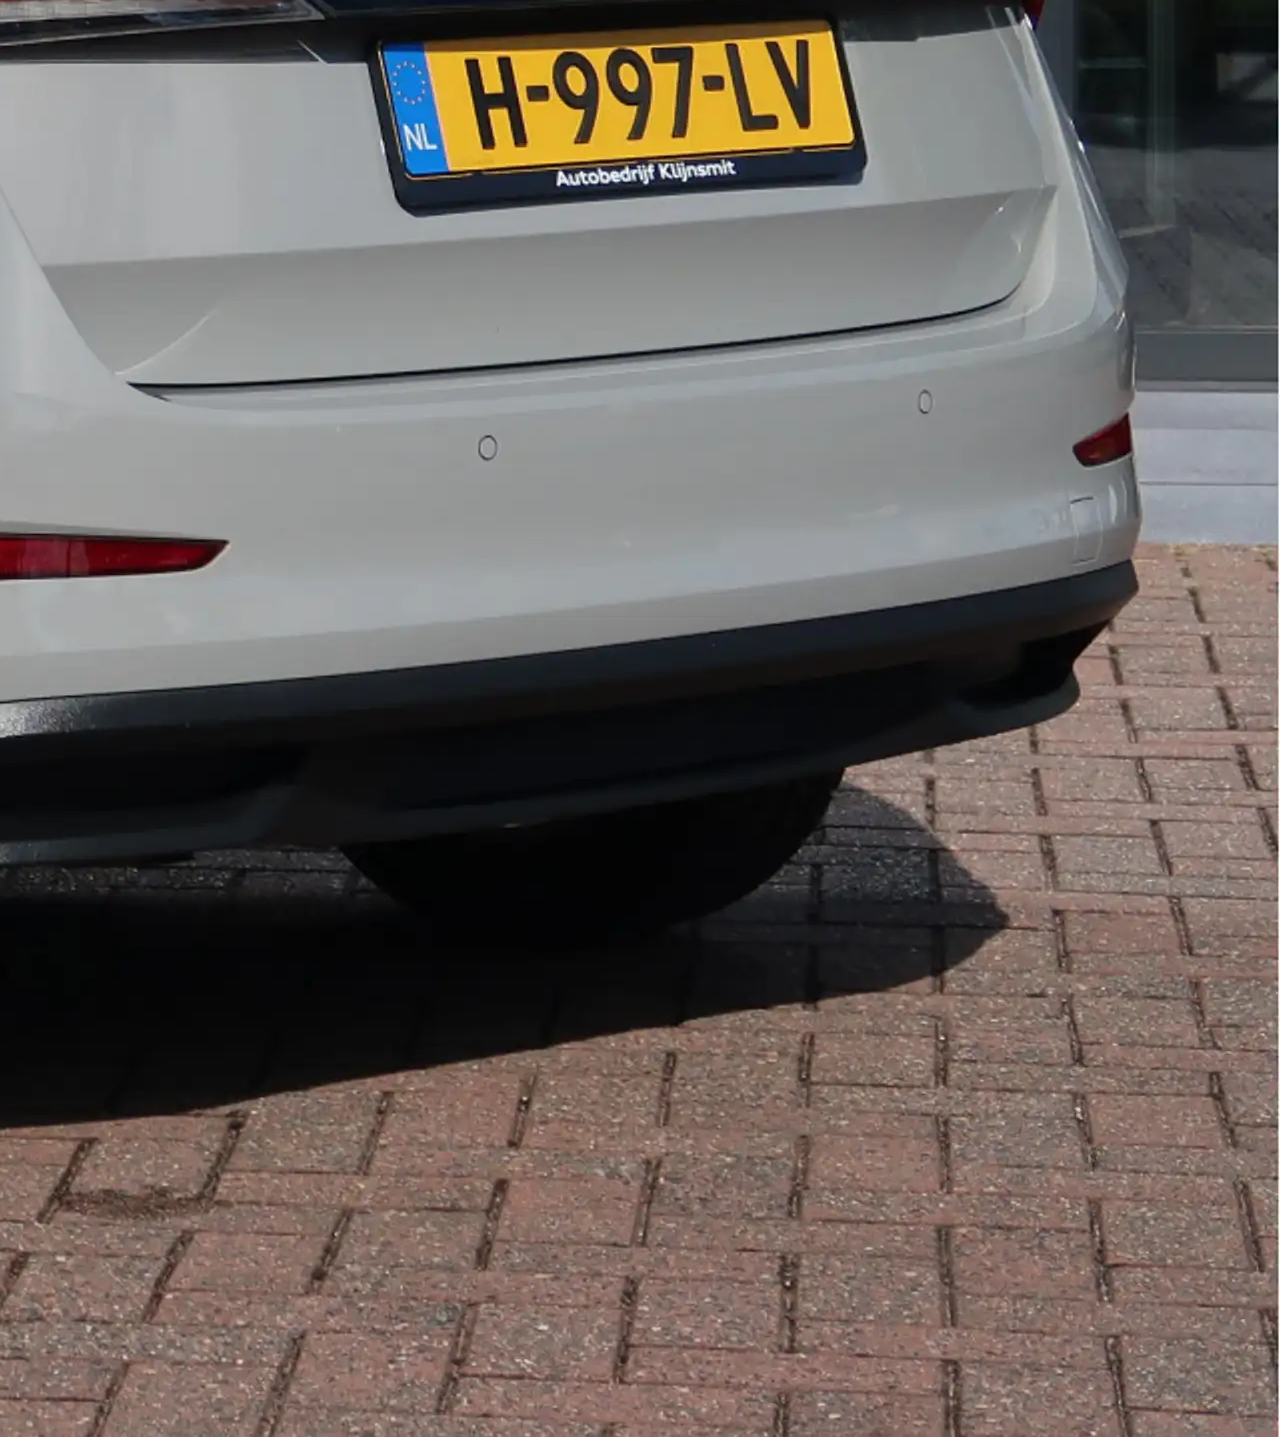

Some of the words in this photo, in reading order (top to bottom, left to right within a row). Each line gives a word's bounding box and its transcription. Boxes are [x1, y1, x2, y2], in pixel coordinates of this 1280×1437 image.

[465, 38, 812, 151] H-997-LV
[403, 123, 437, 152] NL
[556, 163, 655, 188] Autobedrijf
[659, 159, 736, 182] Klijnsmit
